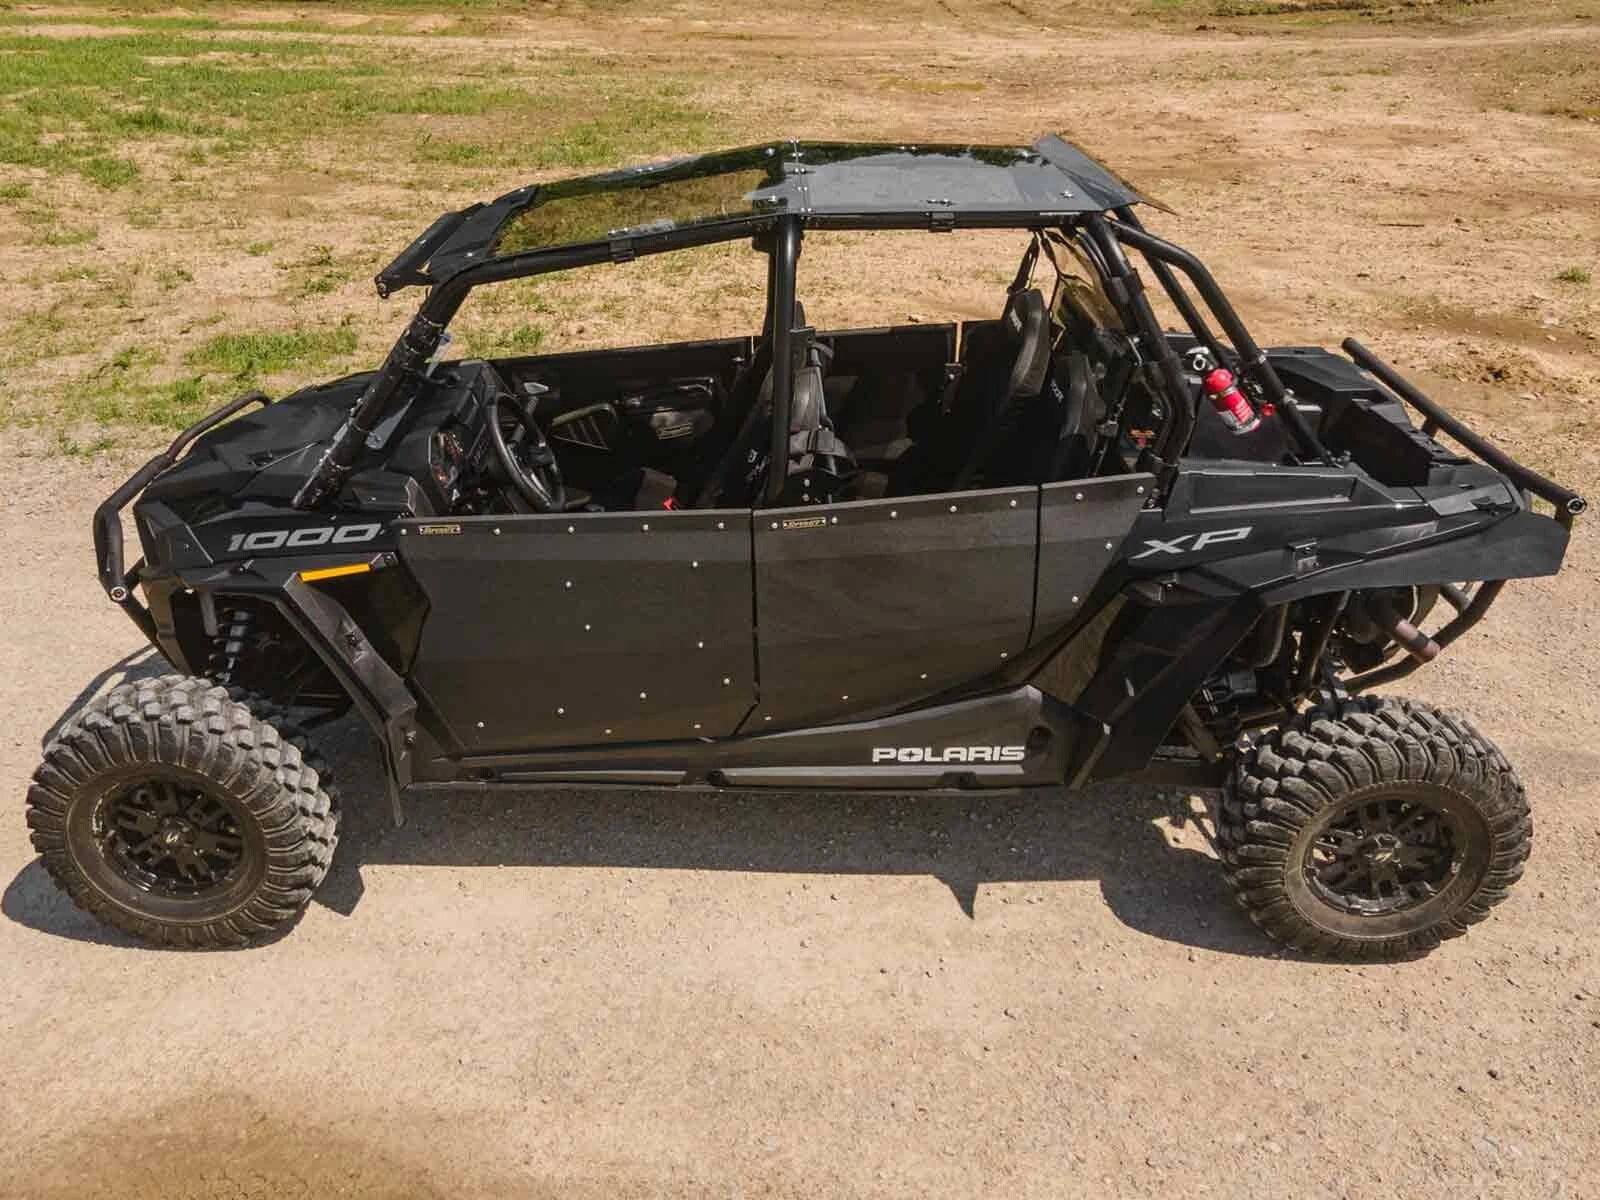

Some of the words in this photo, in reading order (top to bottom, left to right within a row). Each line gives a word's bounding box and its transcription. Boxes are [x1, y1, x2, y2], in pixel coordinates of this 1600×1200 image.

[227, 523, 382, 552] 1000
[1129, 526, 1253, 559] XP
[872, 745, 1025, 763] POLARIS
